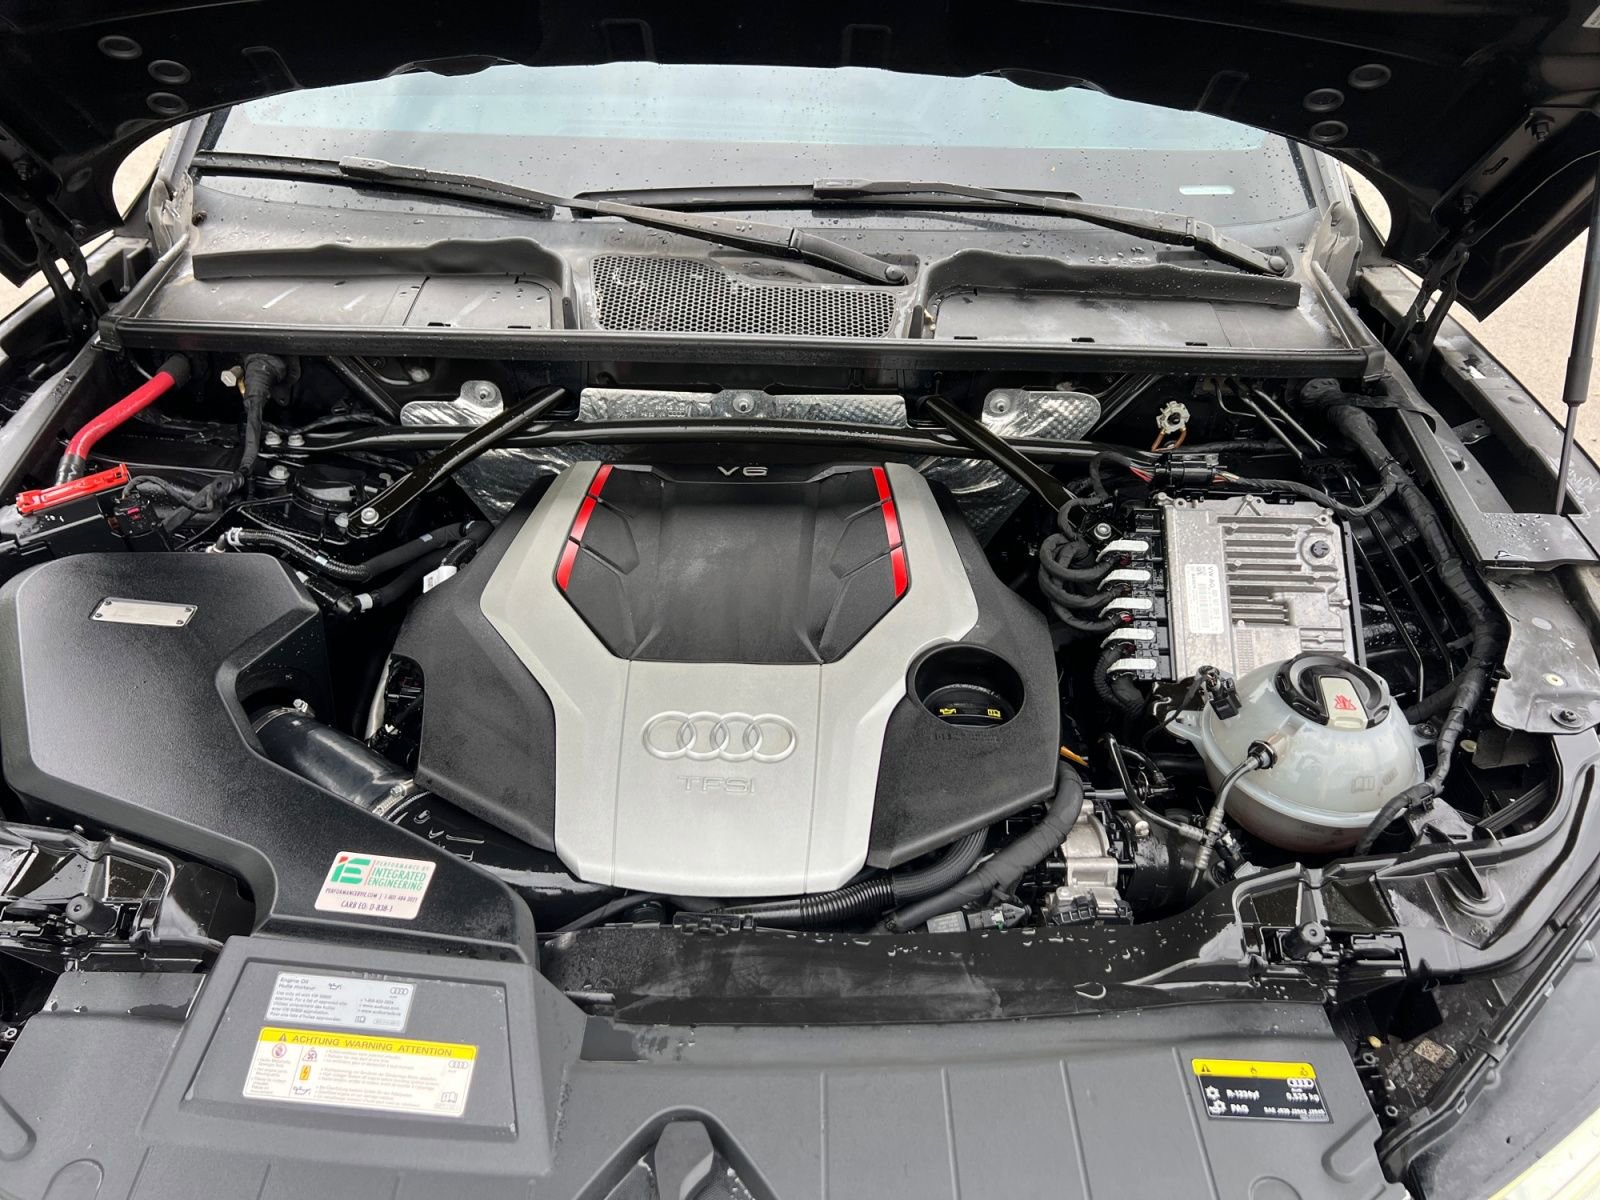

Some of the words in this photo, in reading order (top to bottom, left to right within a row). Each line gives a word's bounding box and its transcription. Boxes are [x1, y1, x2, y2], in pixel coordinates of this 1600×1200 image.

[717, 466, 769, 476] V6
[677, 775, 756, 794] TFSI
[371, 867, 427, 881] INTEGRATED
[367, 876, 423, 891] ENGINEERING
[291, 1035, 340, 1047] ACHTUNG
[345, 1039, 394, 1052] WARNING
[397, 1043, 453, 1057] ATTENTION
